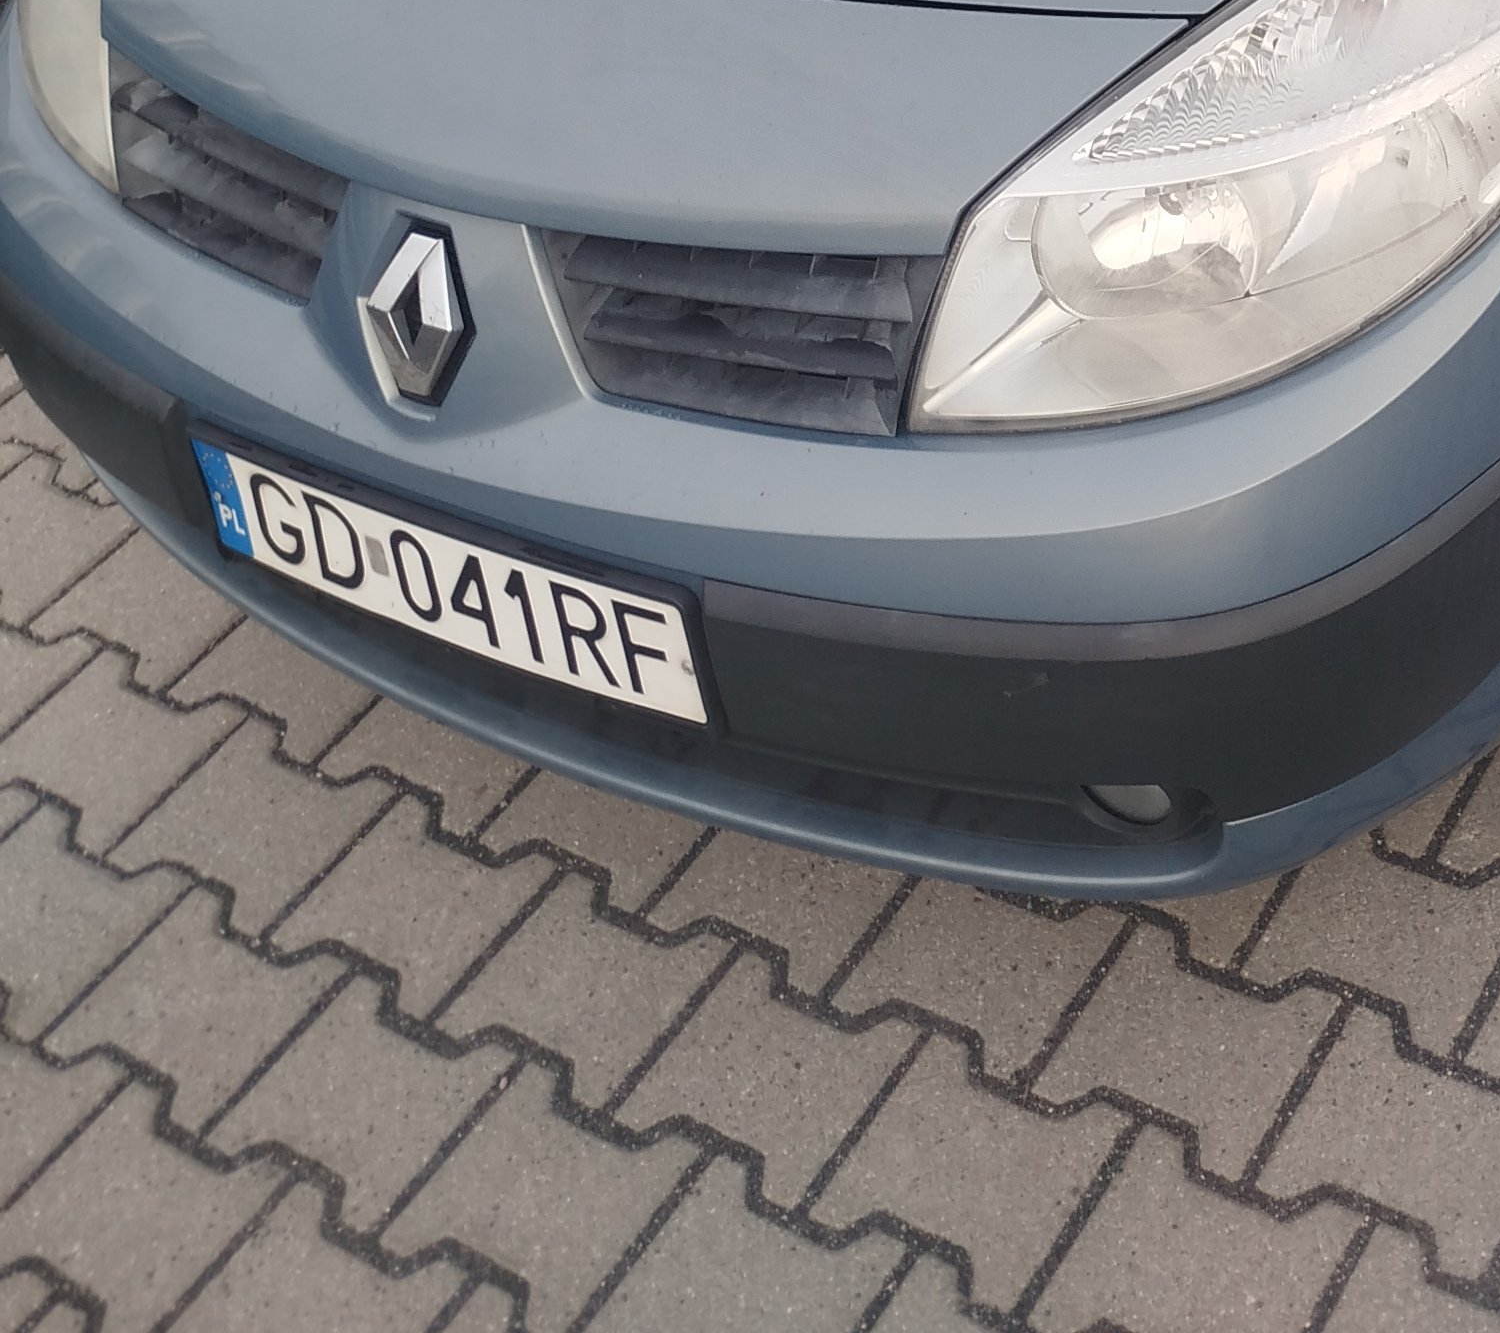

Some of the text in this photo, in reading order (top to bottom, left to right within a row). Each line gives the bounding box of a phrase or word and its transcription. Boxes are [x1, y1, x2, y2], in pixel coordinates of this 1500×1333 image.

[219, 501, 246, 536] PL
[250, 473, 668, 695] GD 041RF
